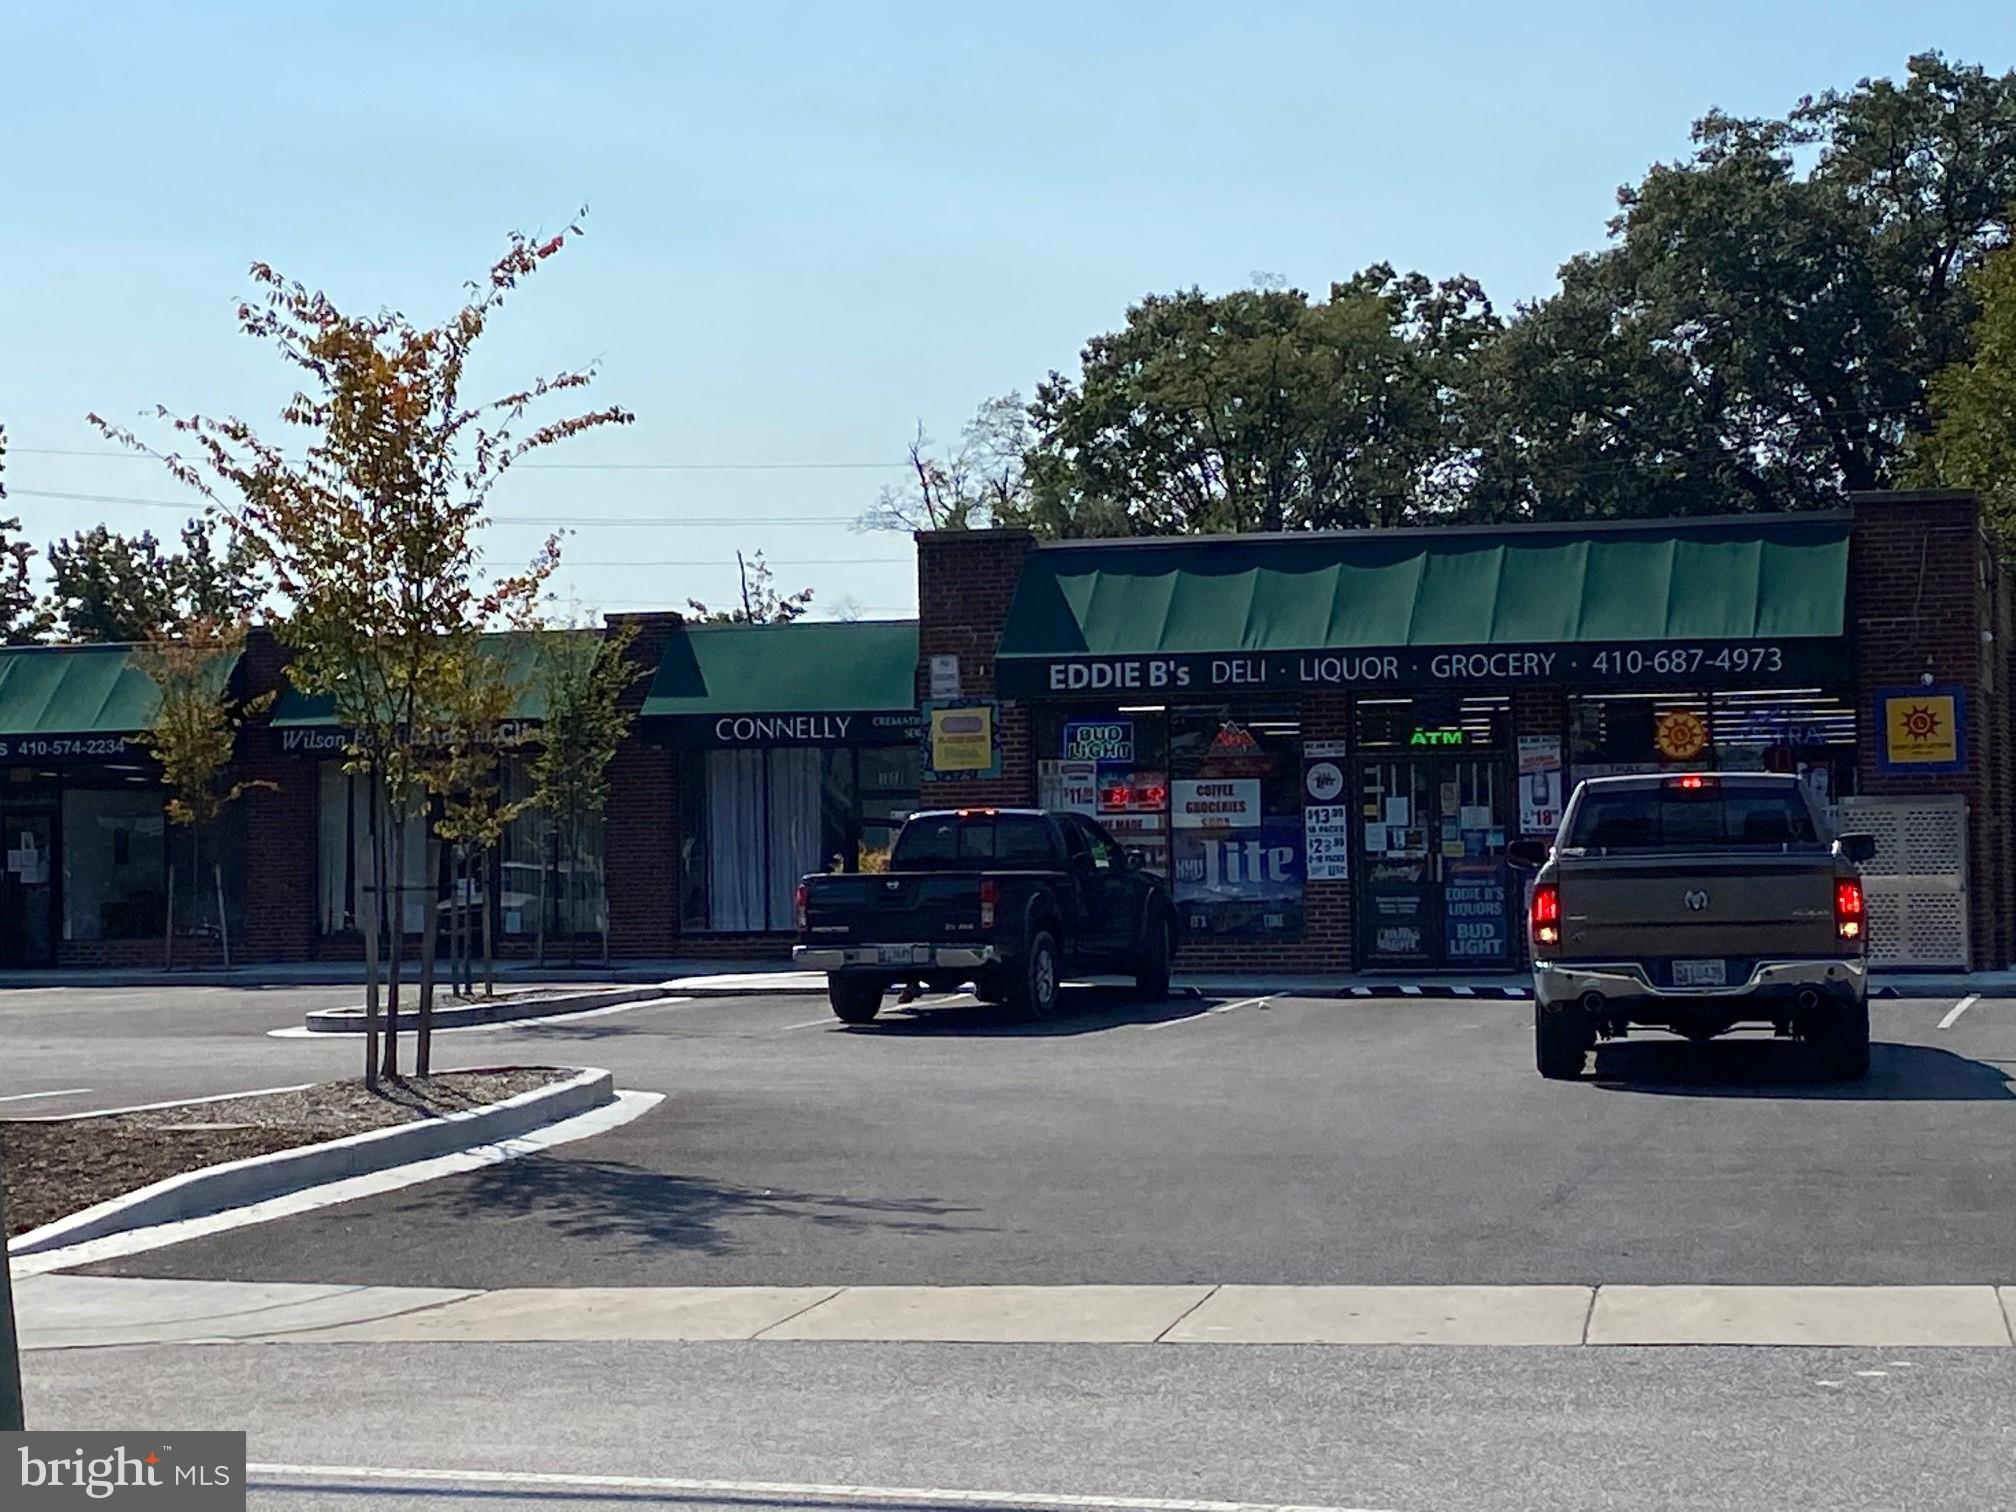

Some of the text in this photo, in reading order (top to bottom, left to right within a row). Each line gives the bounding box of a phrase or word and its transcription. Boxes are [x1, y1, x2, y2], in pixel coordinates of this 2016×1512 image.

[1049, 647, 1783, 690] EDDIE B's DELI LIQUOR GROCERY 410-687-4973
[715, 716, 852, 741] CONNELLY
[1077, 726, 1122, 743] BUD
[282, 728, 346, 752] Wilson
[1409, 730, 1464, 745] ATM
[18, 738, 126, 757] 410-574-2234
[1067, 742, 1130, 760] LIGHT
[1185, 800, 1248, 814] GROCERIES
[1445, 887, 1483, 901] EDDIE
[1448, 902, 1503, 917] LIQUORS
[1456, 922, 1496, 939] BUD
[1448, 939, 1504, 955] LIGHT
